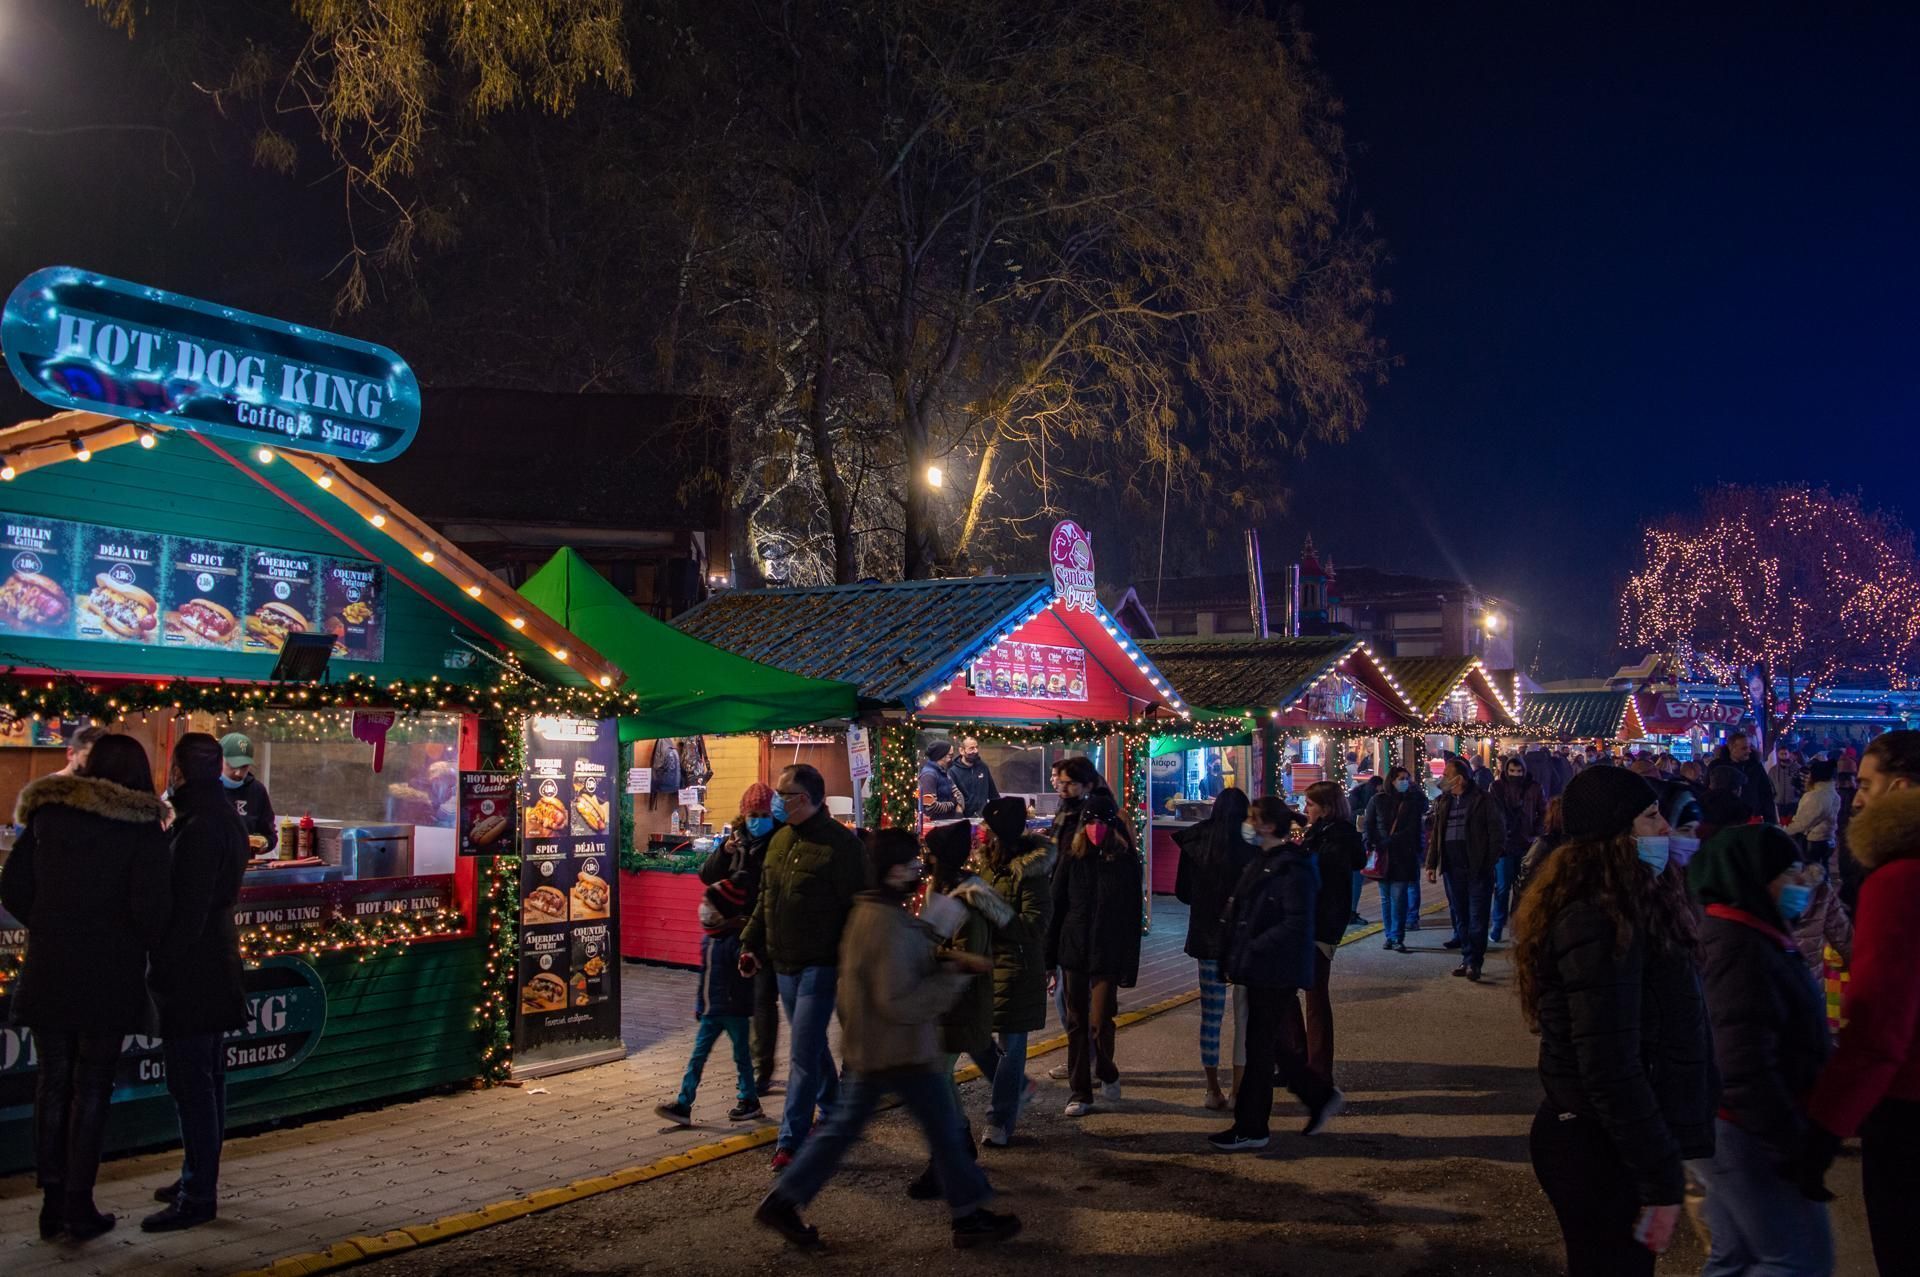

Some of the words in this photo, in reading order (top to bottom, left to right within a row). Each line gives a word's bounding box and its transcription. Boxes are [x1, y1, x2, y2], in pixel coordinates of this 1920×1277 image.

[55, 313, 161, 372] HOT
[175, 340, 266, 398] DOG
[279, 363, 383, 419] KING
[237, 402, 294, 432] Coffee
[297, 413, 313, 434] &
[322, 418, 380, 447] Snacks
[7, 525, 51, 541] BERLIN
[14, 536, 44, 549] Calling
[100, 543, 130, 558] DÉJÀ
[133, 549, 149, 560] VU
[190, 553, 225, 567] SPICY
[258, 557, 309, 571] AMERICAN
[269, 567, 298, 579] Cowboy
[333, 568, 375, 583] COUNTRY
[1055, 567, 1094, 595] Santa's
[1067, 585, 1096, 610] Burger
[368, 714, 391, 726] HERE
[1672, 703, 1741, 725] ΞΟΔΟΣ
[1151, 757, 1177, 769] λιάφα
[466, 774, 487, 784] HOT
[490, 774, 509, 784] DOG
[473, 783, 506, 794] Classic
[536, 844, 558, 854] SPICY
[596, 843, 605, 852] VU
[356, 901, 381, 915] HOT
[383, 899, 408, 913] DOG
[410, 896, 439, 910] KING
[234, 910, 252, 926] OT
[256, 908, 283, 924] DOG
[287, 905, 320, 921] KING
[574, 925, 607, 937] COUNTRY
[526, 933, 564, 945] AMERICAN
[227, 1042, 287, 1068] Snacks
